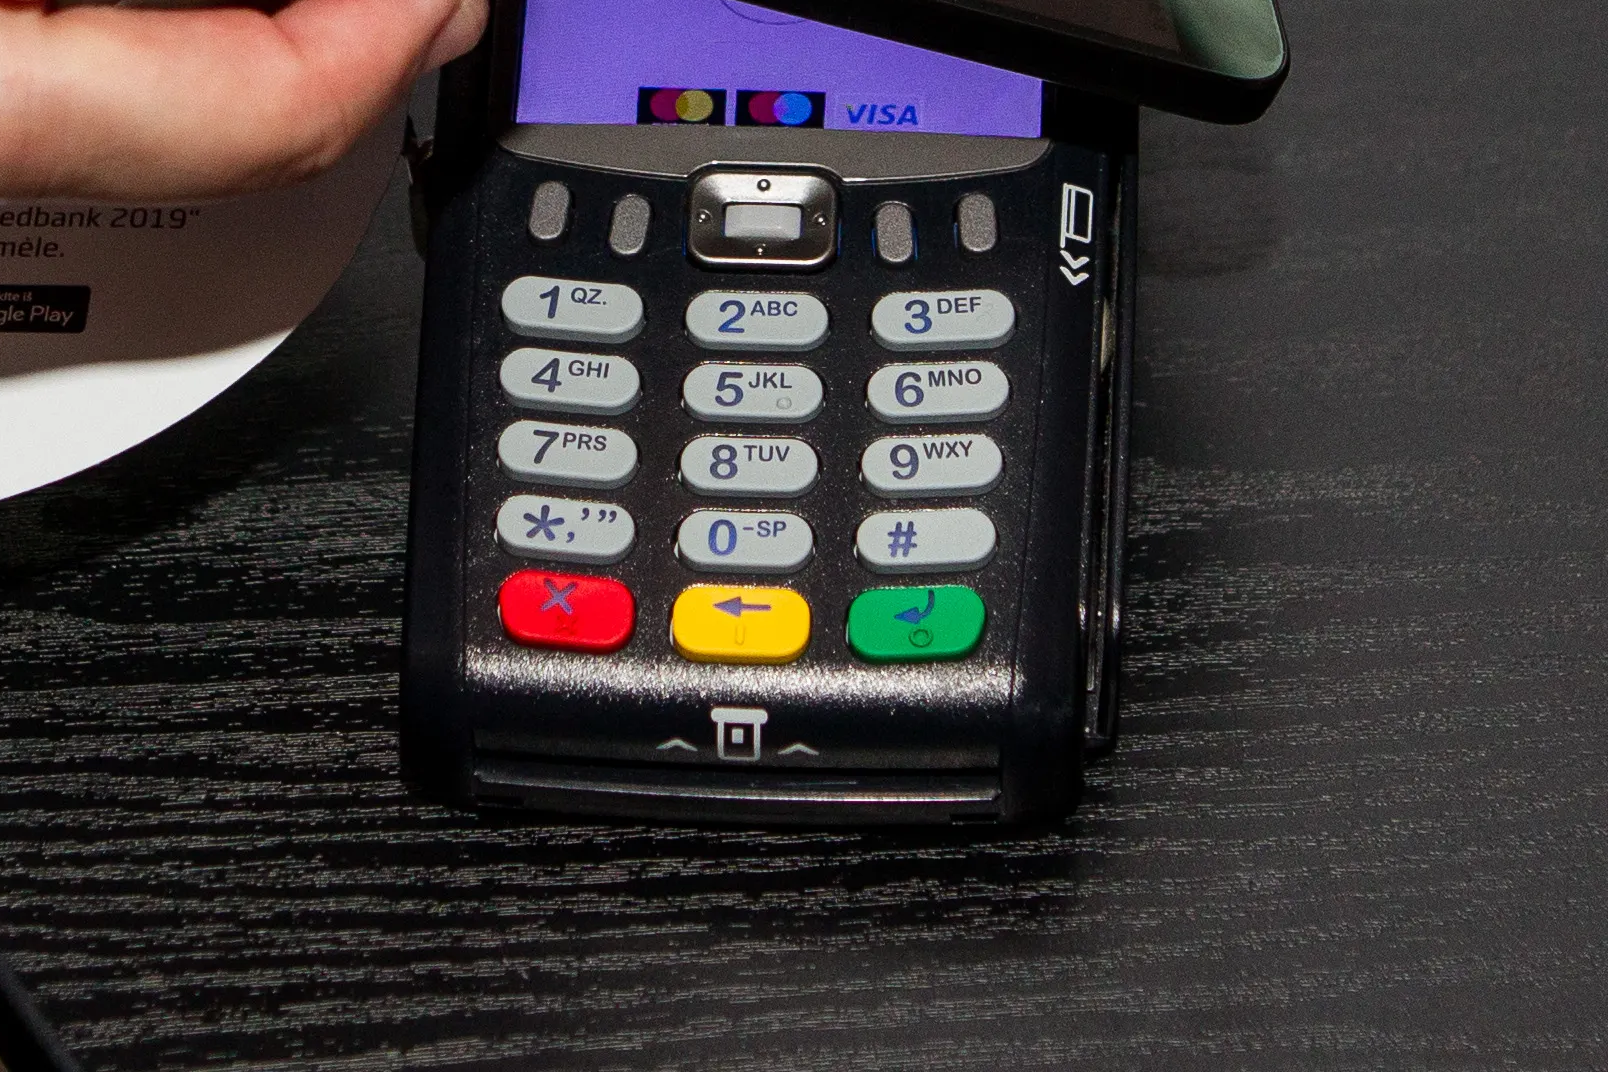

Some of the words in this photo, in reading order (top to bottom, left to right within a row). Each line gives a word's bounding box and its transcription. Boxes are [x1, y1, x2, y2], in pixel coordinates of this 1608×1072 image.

[845, 103, 919, 126] VISA
[22, 289, 33, 303] iš
[539, 285, 561, 319] 1
[570, 287, 607, 305] QZ.
[30, 305, 75, 326] Play
[718, 299, 746, 334] 2
[750, 300, 798, 317] ABC
[904, 299, 933, 335] 3
[936, 296, 982, 315] DEF
[530, 357, 562, 393] 4
[568, 359, 610, 379] GHI
[714, 371, 744, 407] 5
[748, 371, 792, 389] JKL
[894, 371, 925, 408] 6
[928, 368, 982, 387] MNO
[533, 429, 560, 464] 7
[562, 432, 607, 452] PRS
[709, 443, 739, 479] 8
[743, 445, 790, 462] TUV
[889, 443, 920, 480] 9
[922, 440, 973, 460] WXY
[707, 518, 738, 557] 0
